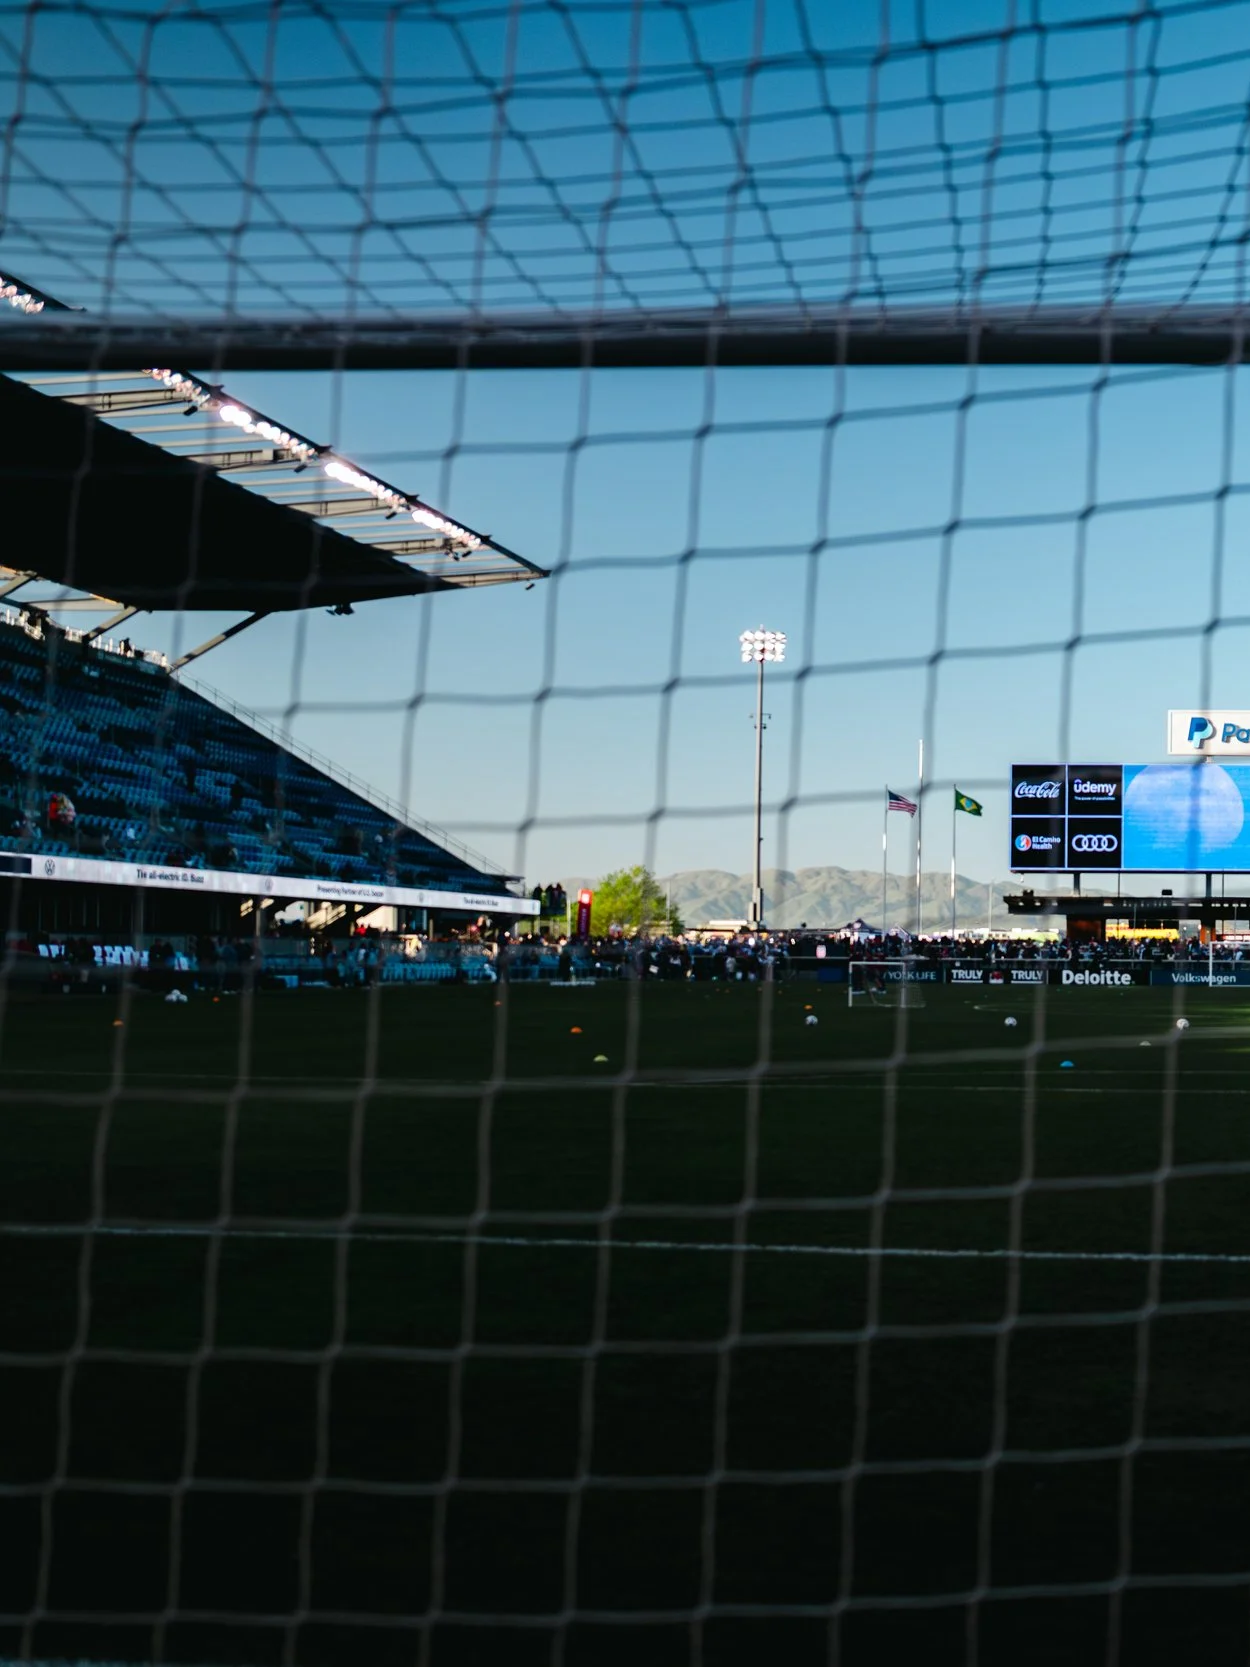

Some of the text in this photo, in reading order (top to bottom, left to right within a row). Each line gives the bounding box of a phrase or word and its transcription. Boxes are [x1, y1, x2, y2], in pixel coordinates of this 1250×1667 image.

[1073, 779, 1117, 797] udemy
[916, 971, 936, 980] LIFE
[951, 970, 983, 979] TRULY
[1011, 970, 1043, 980] TRULY
[1172, 973, 1236, 985] Volkswagen
